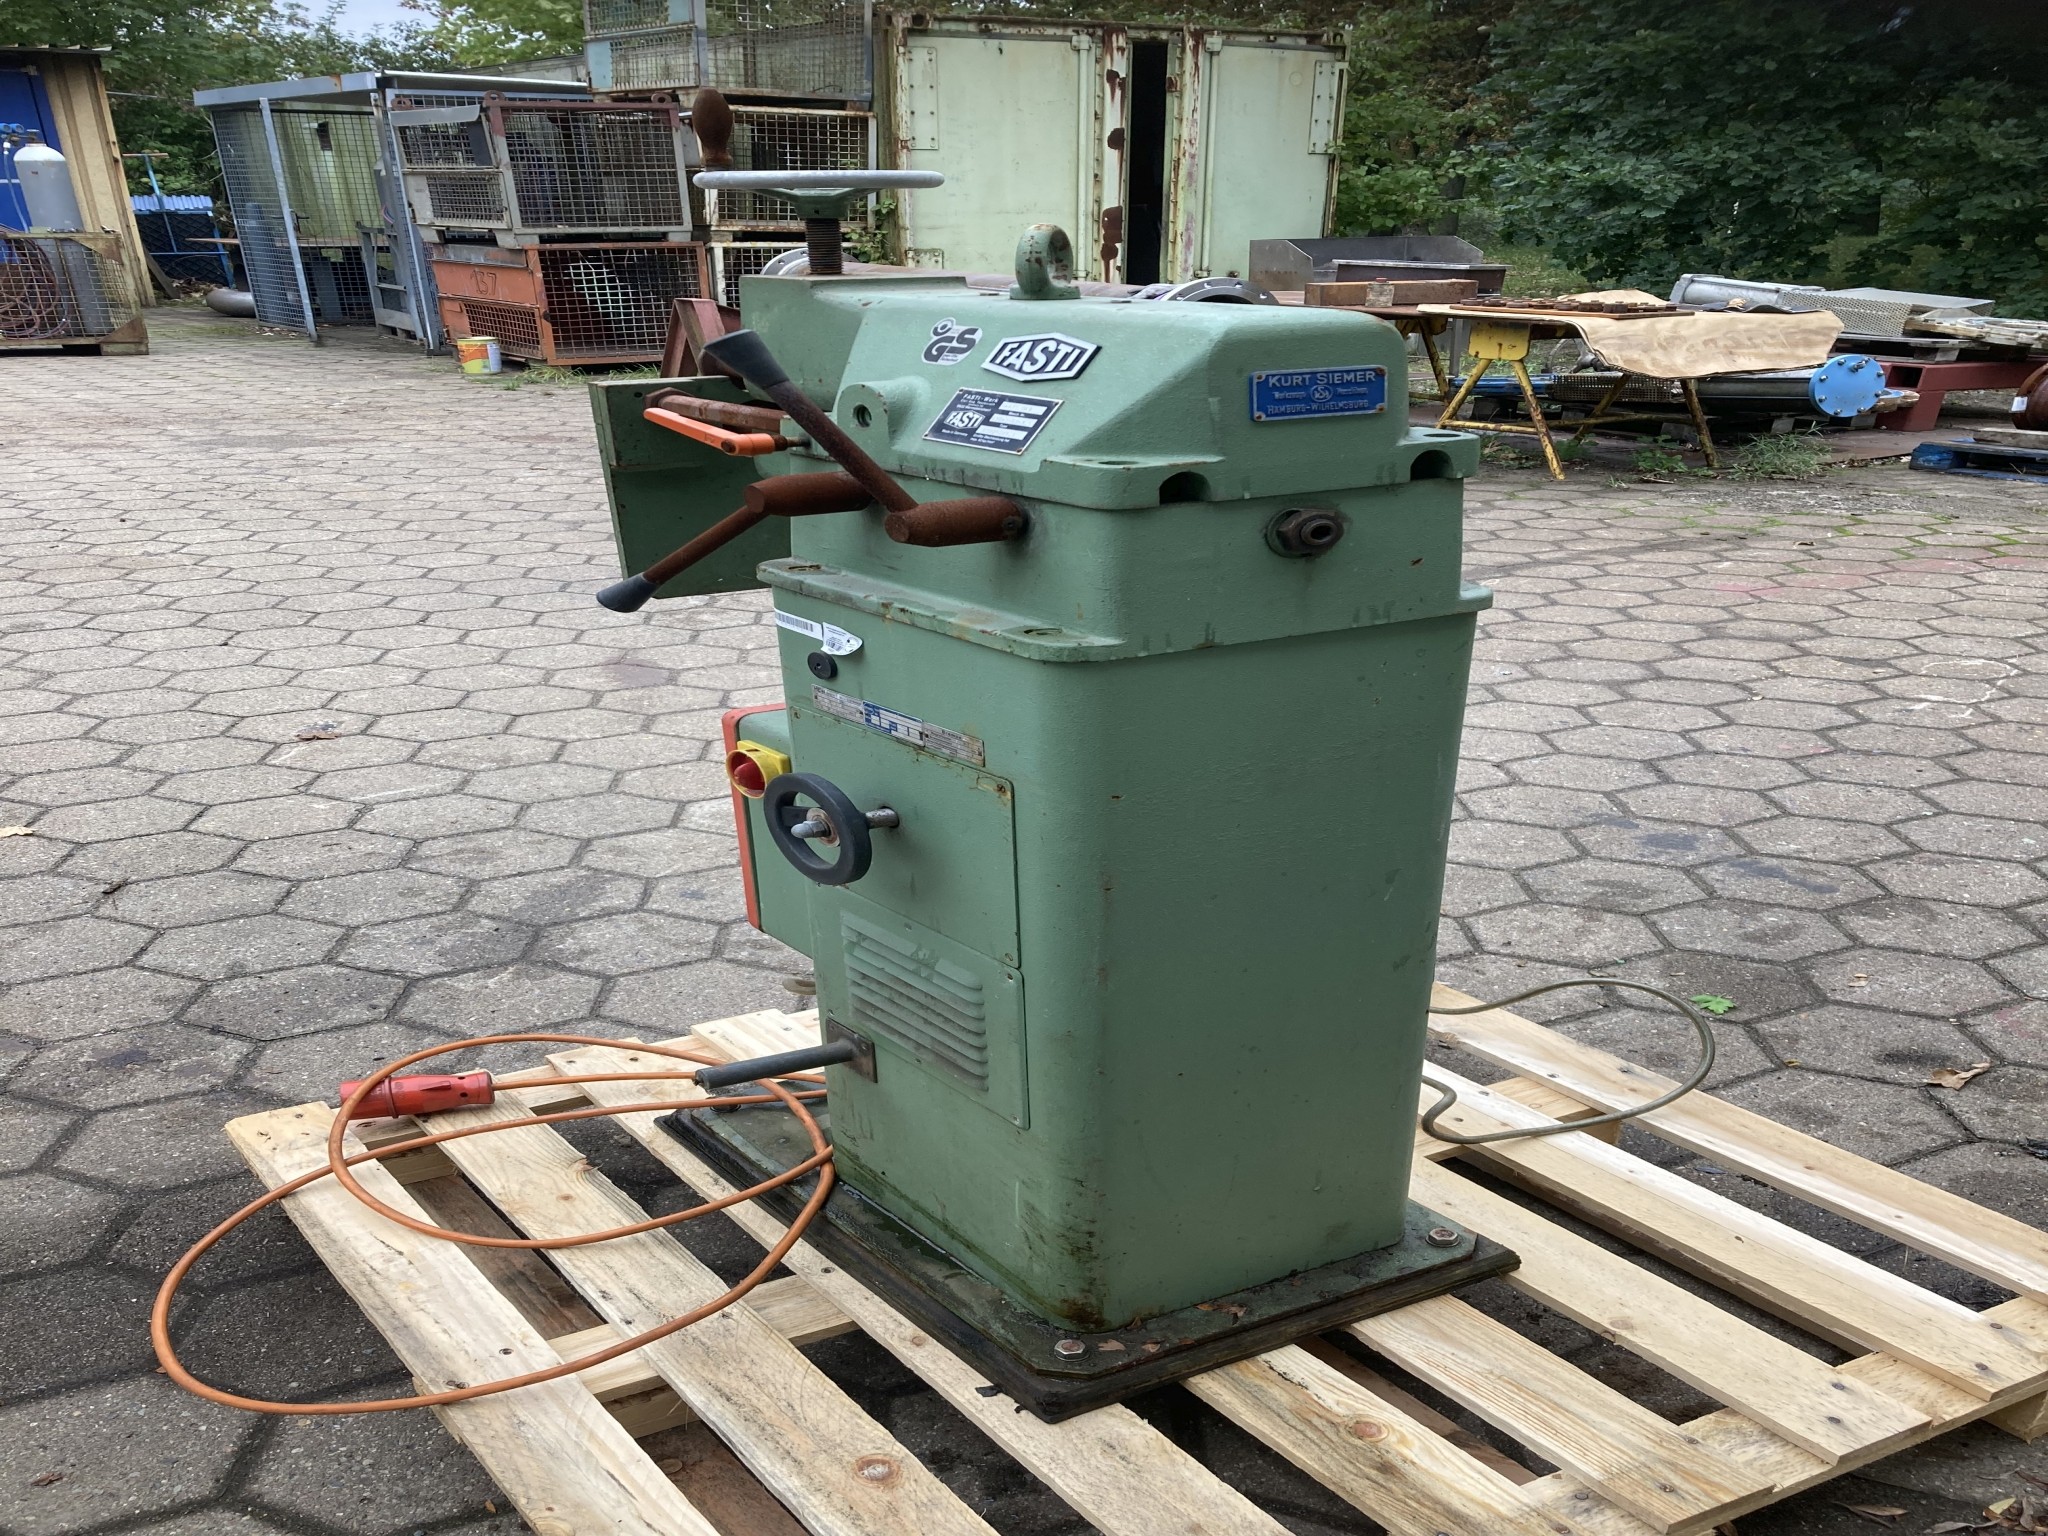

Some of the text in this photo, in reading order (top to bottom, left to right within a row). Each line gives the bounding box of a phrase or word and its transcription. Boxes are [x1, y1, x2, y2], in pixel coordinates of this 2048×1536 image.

[923, 327, 980, 363] GS
[994, 340, 1082, 373] FASTI
[1268, 371, 1376, 388] KURT SIEMER
[1267, 400, 1369, 415] HAMBURG-WILHELMSBURG
[946, 411, 982, 428] FASTI
